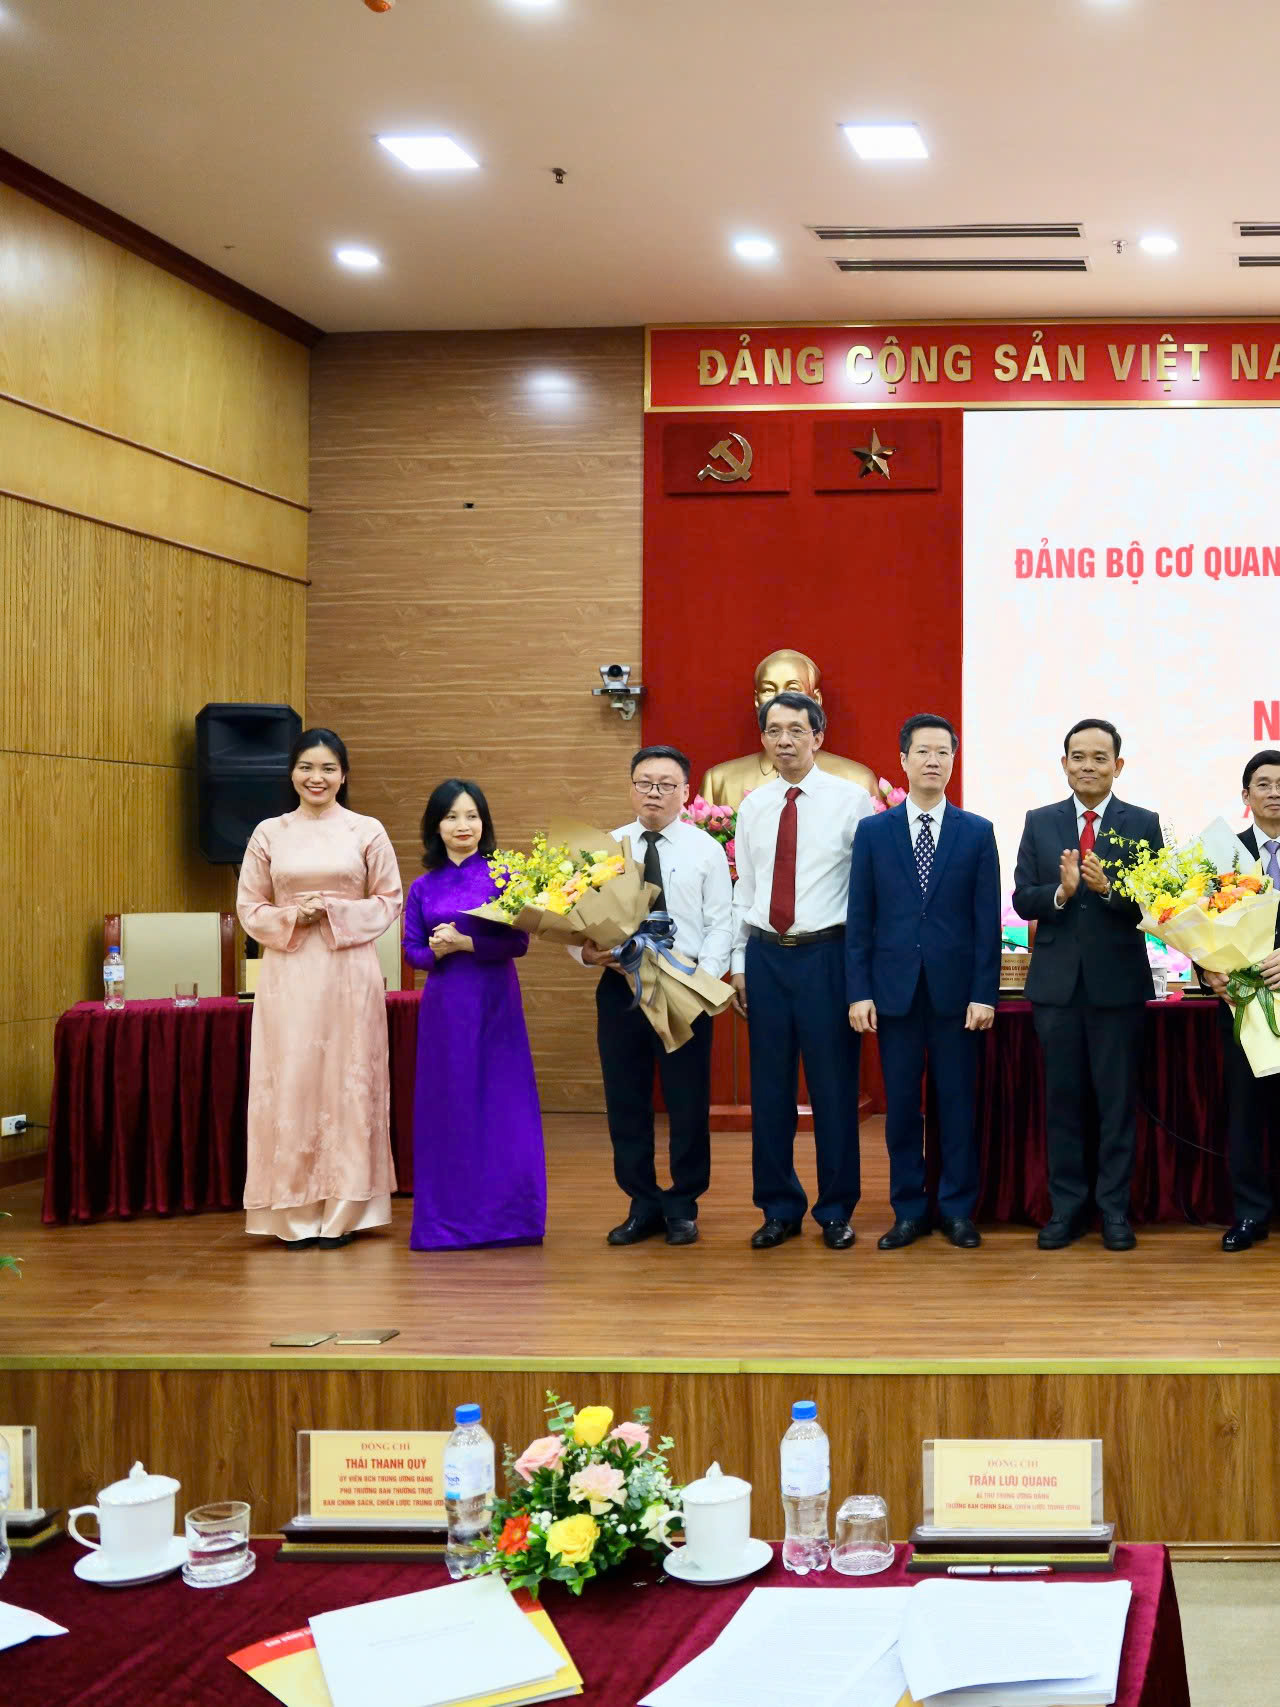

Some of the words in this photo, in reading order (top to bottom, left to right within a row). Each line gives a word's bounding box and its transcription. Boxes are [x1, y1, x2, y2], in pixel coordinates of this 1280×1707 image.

[698, 334, 826, 386] ĐẢNG
[845, 336, 973, 395] CỘNG
[993, 330, 1086, 383] SẢN
[1108, 334, 1210, 393] VIỆT
[1015, 537, 1096, 579] ĐẢNG
[1106, 541, 1145, 585] BỘ
[1155, 544, 1195, 577] CƠ
[370, 1456, 404, 1470] THANH
[1022, 1473, 1058, 1487] QUANG
